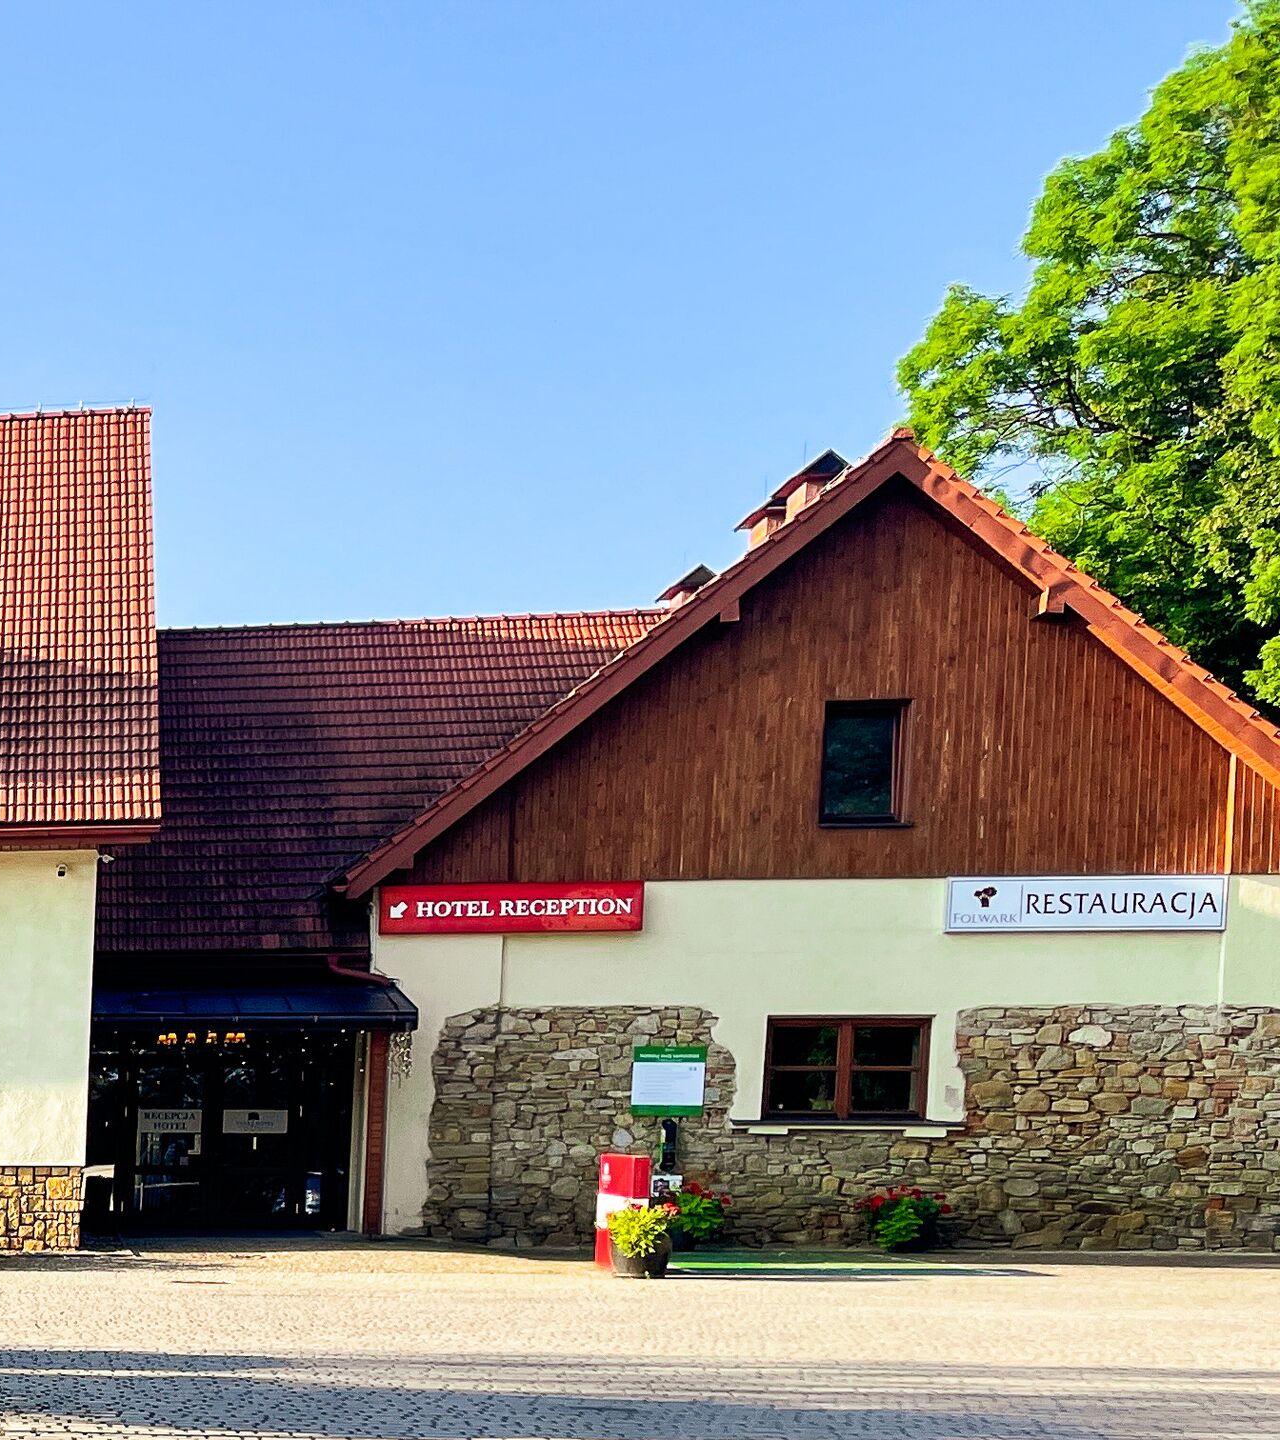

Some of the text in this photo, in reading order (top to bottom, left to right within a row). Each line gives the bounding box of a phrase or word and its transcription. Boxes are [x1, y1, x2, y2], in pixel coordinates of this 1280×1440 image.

[416, 898, 633, 918] HOTEL RECEPTION
[1026, 891, 1217, 919] RESTAURACJA
[953, 912, 1017, 924] FOLWARK
[143, 1111, 196, 1120] RECEPCJA
[153, 1121, 187, 1130] HOTEL
